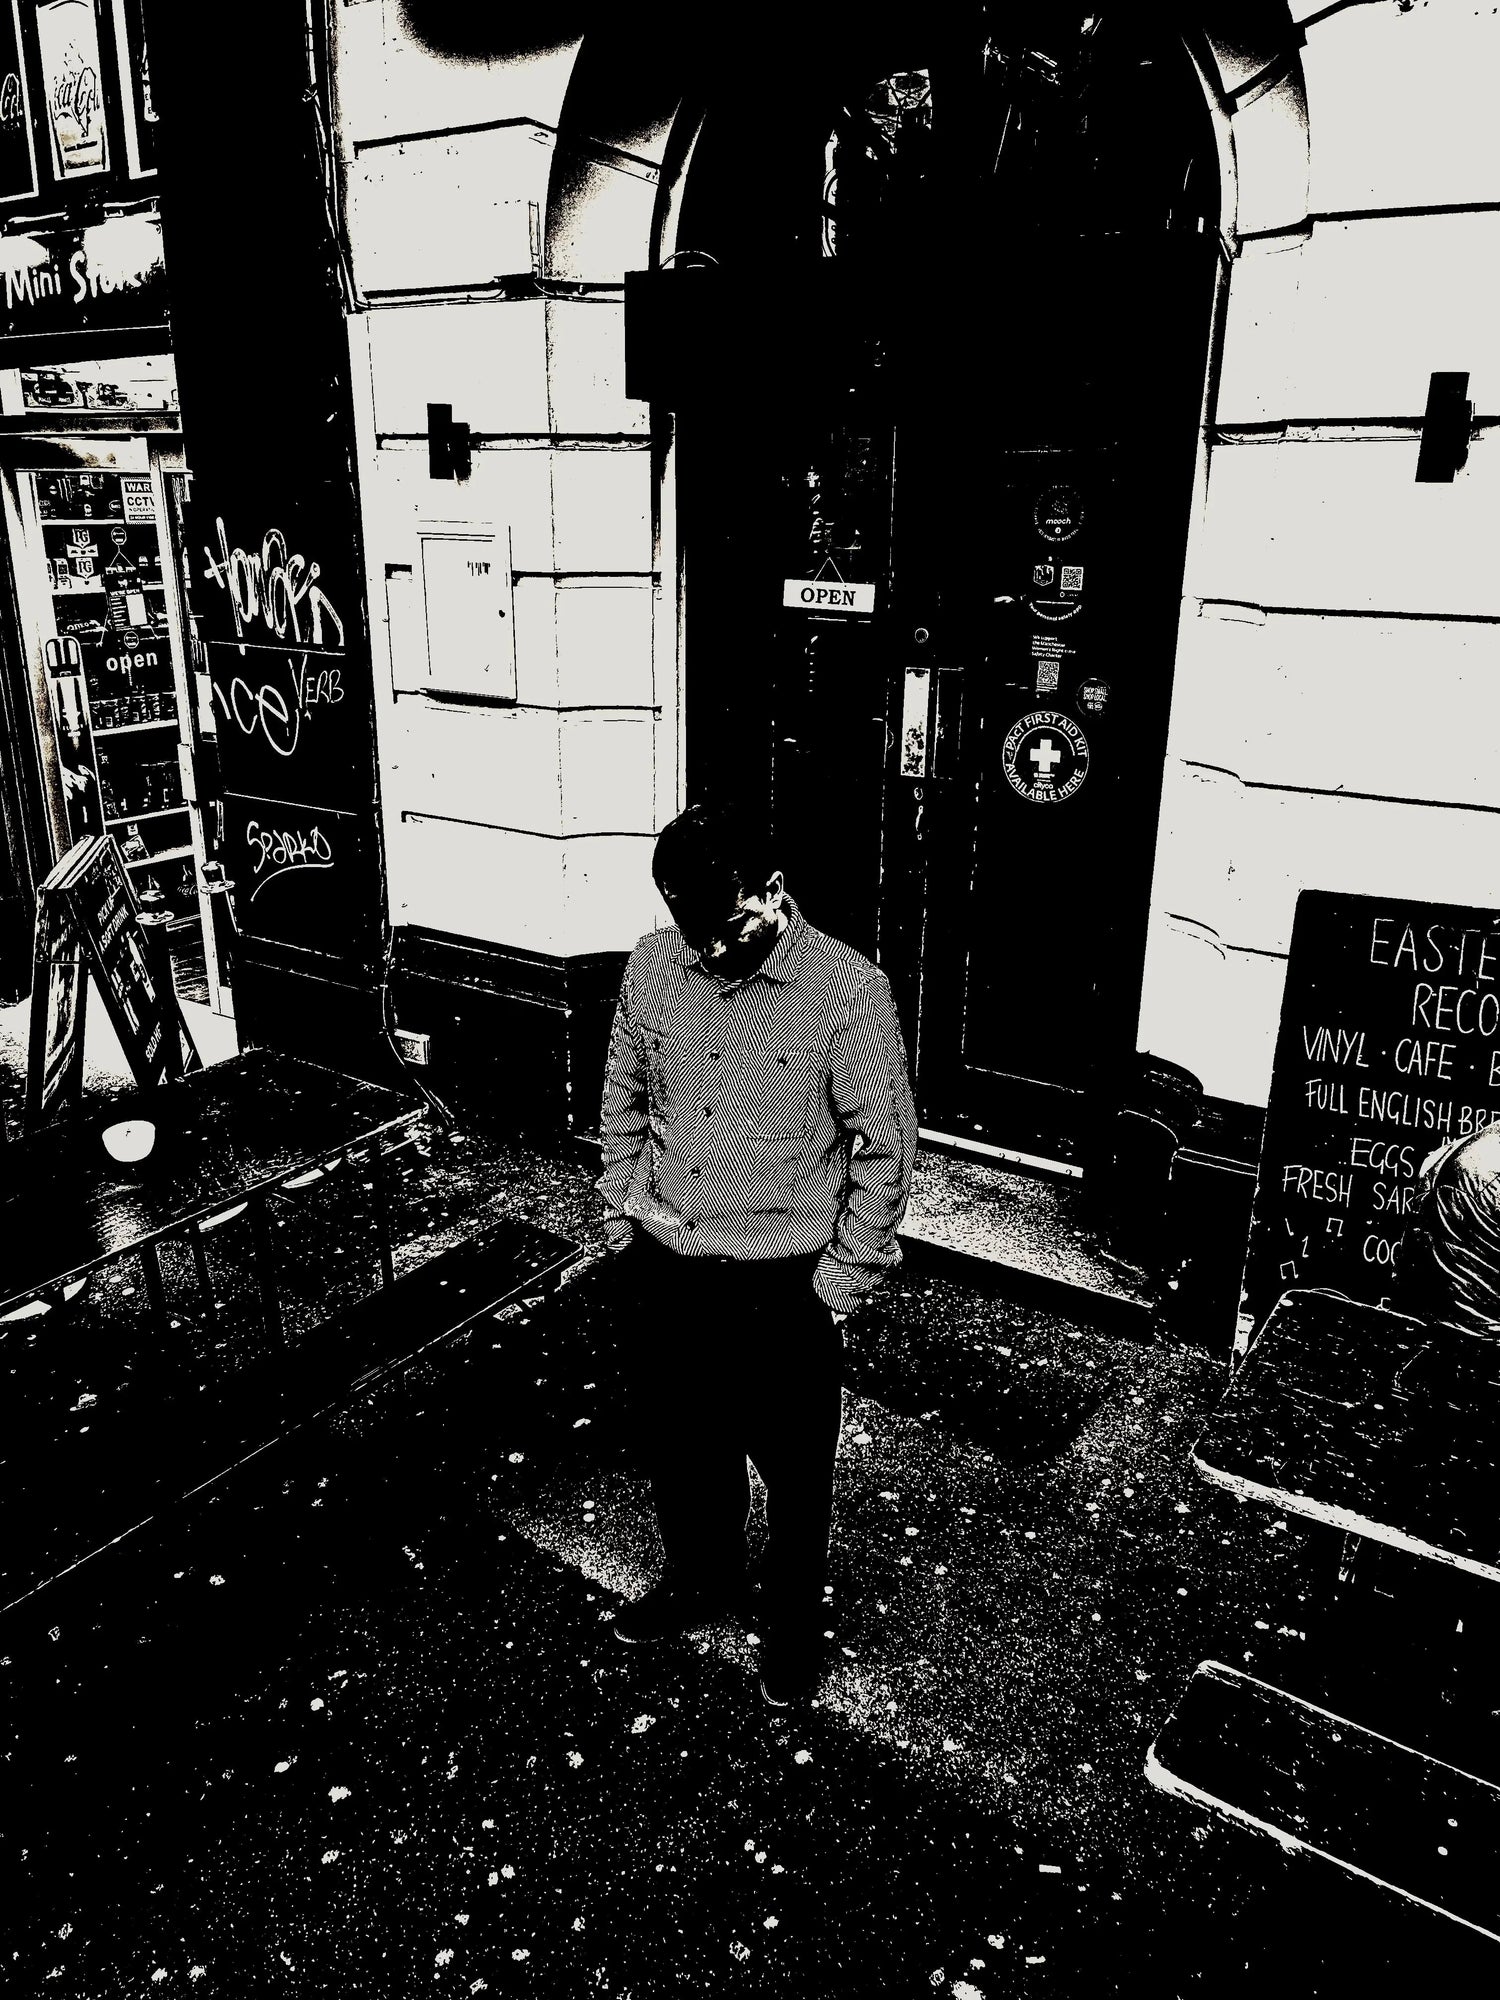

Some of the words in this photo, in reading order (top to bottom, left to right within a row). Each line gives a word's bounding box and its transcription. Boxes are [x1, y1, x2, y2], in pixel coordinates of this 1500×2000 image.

[4, 264, 61, 309] Mini
[1045, 516, 1072, 525] mooch
[800, 588, 857, 606] OPEN
[106, 652, 158, 674] open
[1024, 713, 1060, 729] FIRST
[1057, 718, 1079, 737] AID
[1074, 737, 1088, 758] KIT
[1005, 763, 1058, 801] AVAILABLE
[1057, 768, 1085, 798] HERE
[1412, 982, 1500, 1036] RECO
[1303, 1024, 1370, 1068] VINYL
[1395, 1038, 1457, 1081] CAFE
[1305, 1078, 1348, 1114] FULL
[1359, 1086, 1453, 1133] ENGLISH
[1350, 1137, 1415, 1179] EGGS
[1281, 1164, 1354, 1208] FRESH
